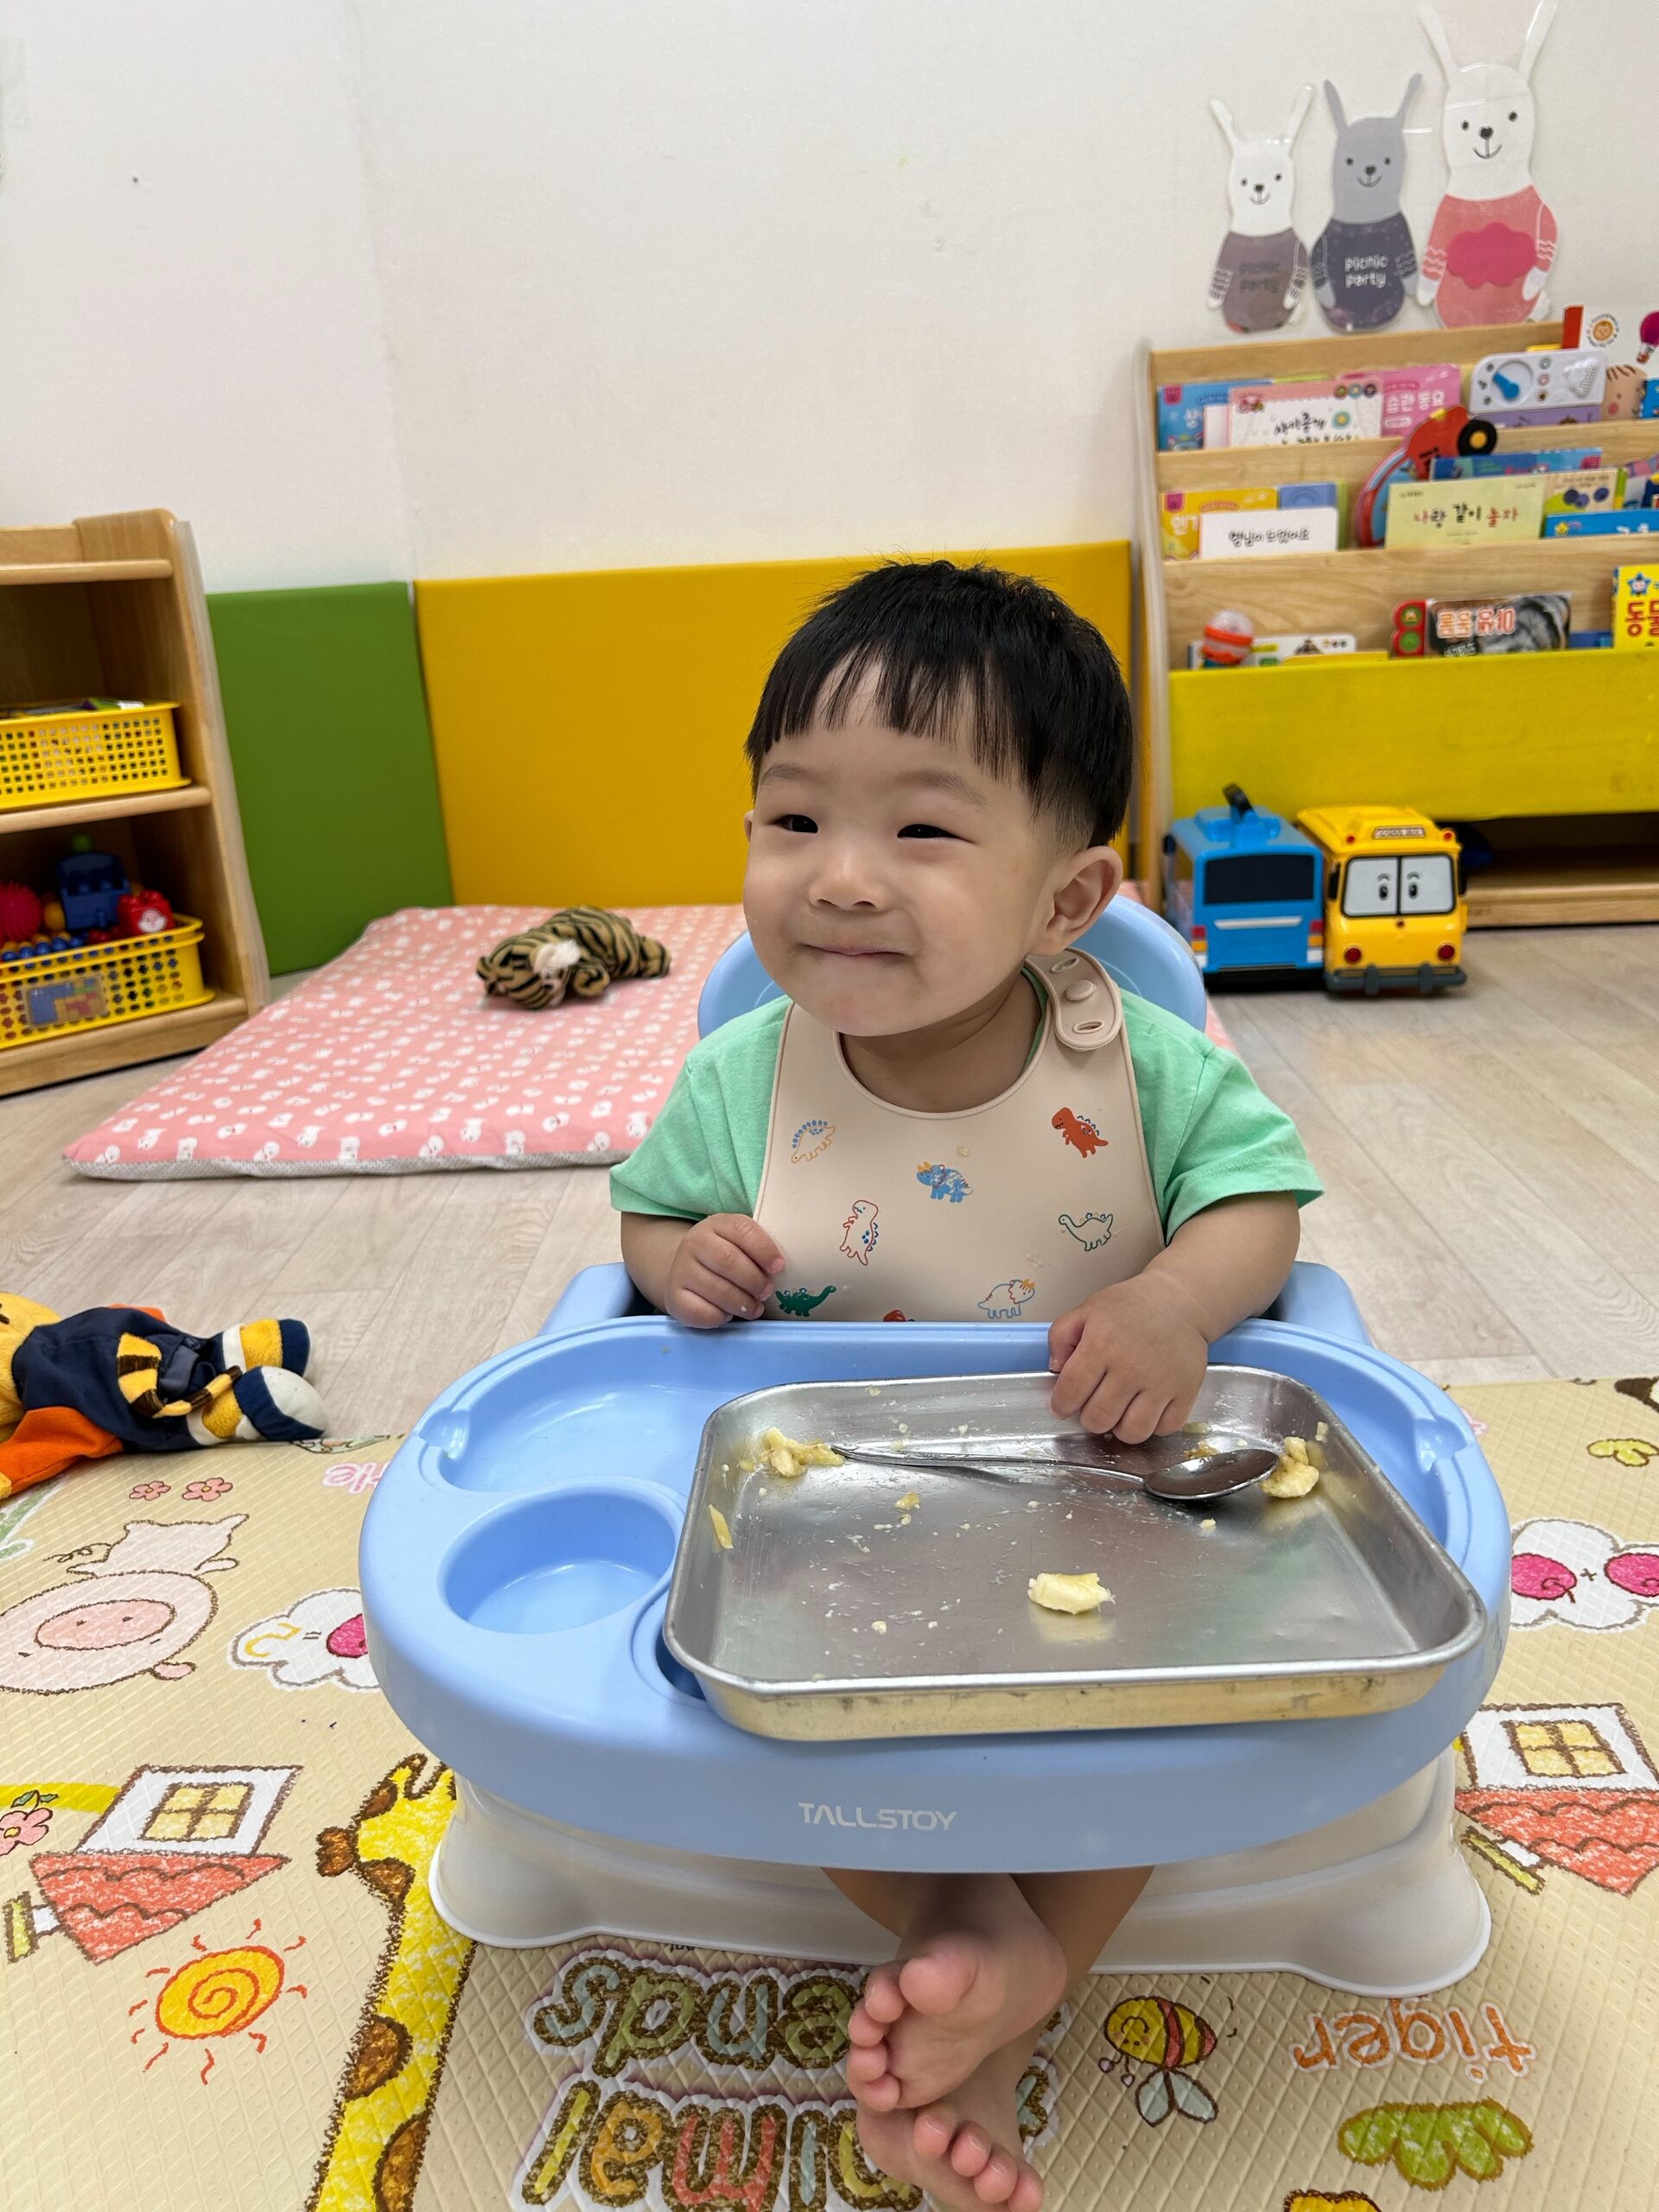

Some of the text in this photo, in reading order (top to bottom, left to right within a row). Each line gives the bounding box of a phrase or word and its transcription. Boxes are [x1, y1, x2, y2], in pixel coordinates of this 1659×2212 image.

[1413, 501, 1518, 528] 나랑 같이 놀자
[798, 1802, 957, 1832] TALLSTOY
[1293, 1997, 1534, 2083] tiger
